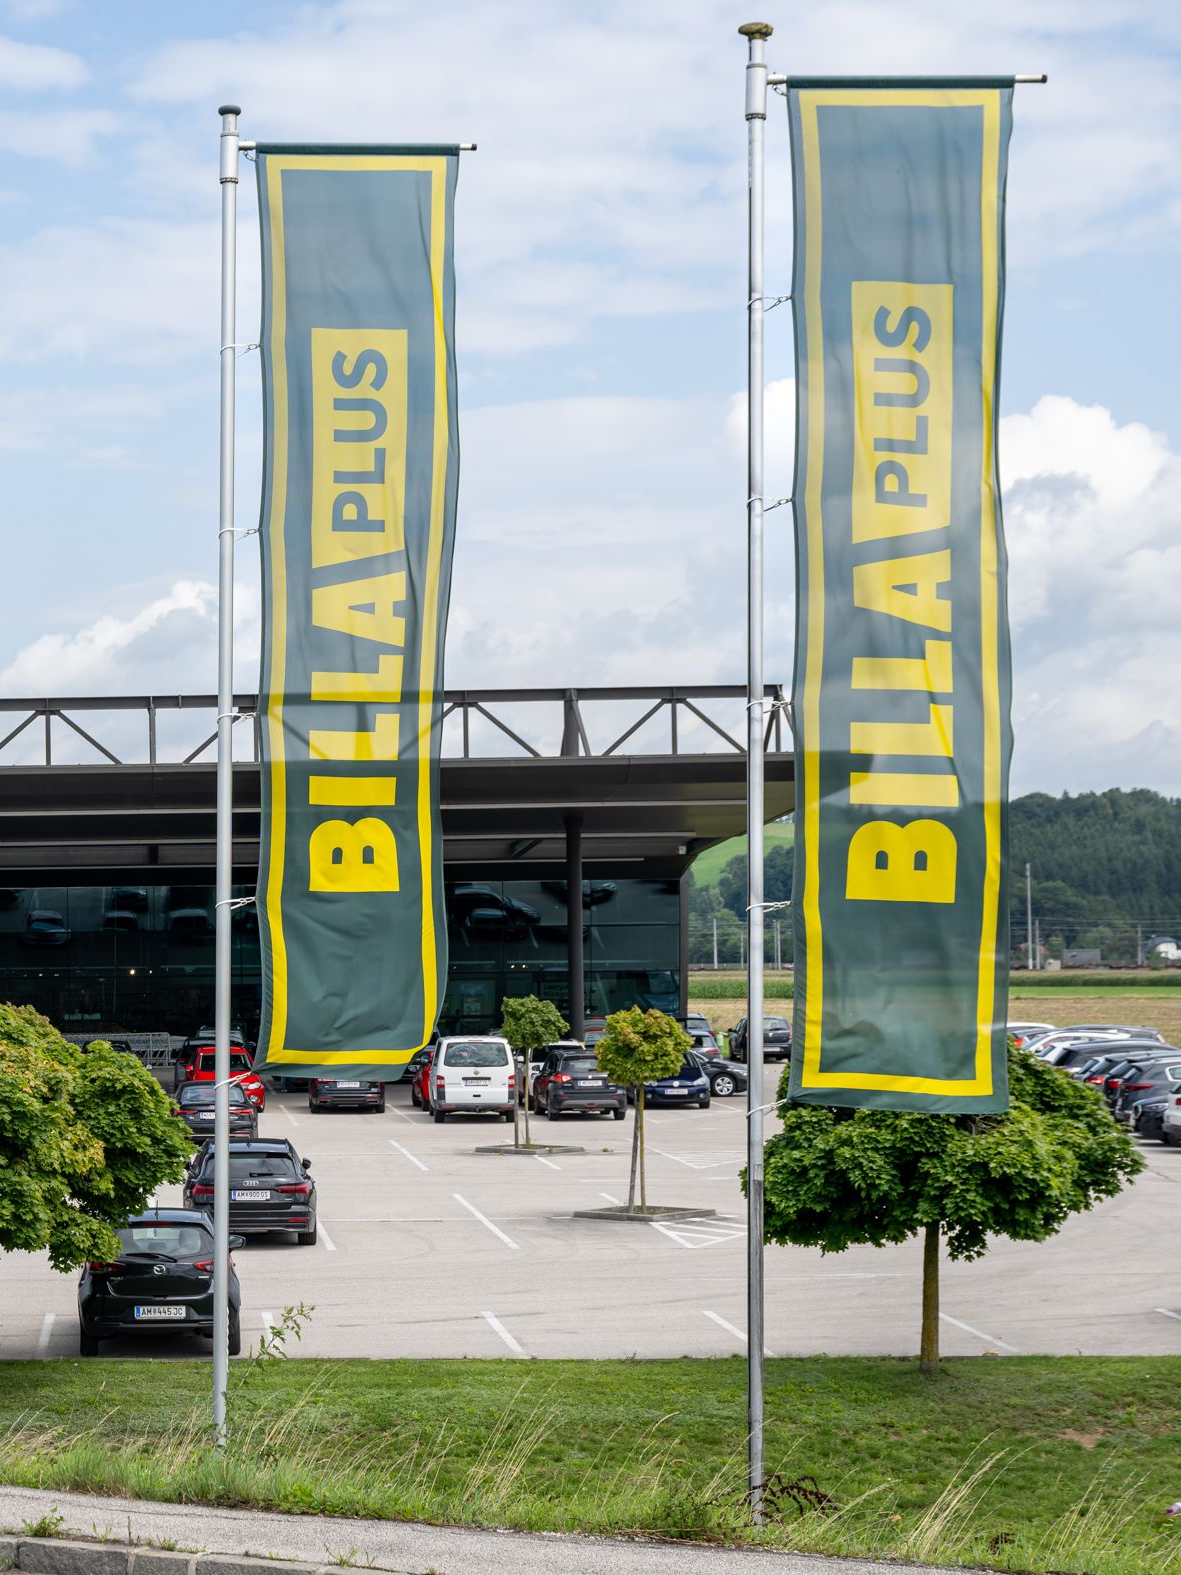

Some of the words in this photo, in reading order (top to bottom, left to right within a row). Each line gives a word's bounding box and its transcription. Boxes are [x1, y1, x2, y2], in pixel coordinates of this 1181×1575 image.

[331, 348, 388, 533] PLUS
[873, 304, 932, 507] PLUS
[309, 570, 407, 892] BILLA
[845, 549, 959, 903] BILLA
